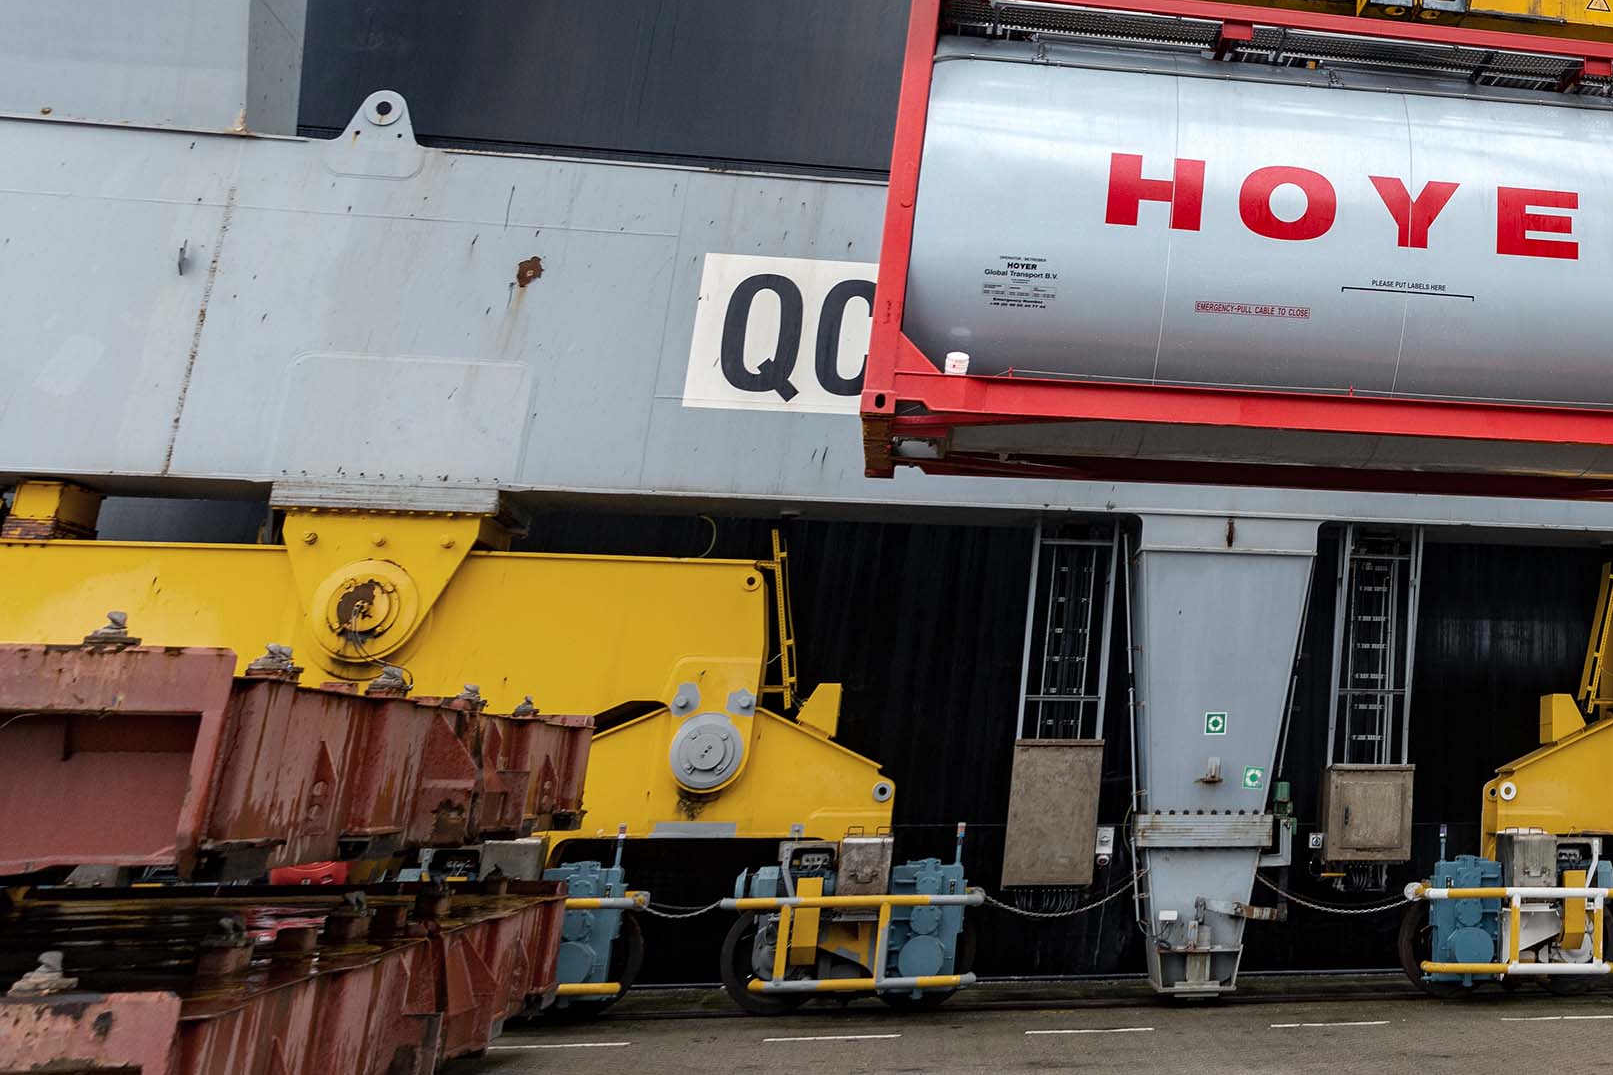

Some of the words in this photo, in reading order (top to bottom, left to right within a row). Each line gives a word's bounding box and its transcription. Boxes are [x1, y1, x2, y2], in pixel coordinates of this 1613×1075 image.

[1007, 262, 1037, 270] HOYER
[984, 268, 1008, 276] Global
[1009, 270, 1043, 279] Transport
[1371, 279, 1394, 288] PLEASE
[1407, 283, 1430, 291] LABELS
[1196, 302, 1252, 314] EMERGENCY-PULL
[1254, 305, 1275, 315] CABLE
[1278, 307, 1286, 315] TO
[1288, 308, 1309, 317] CLOSE
